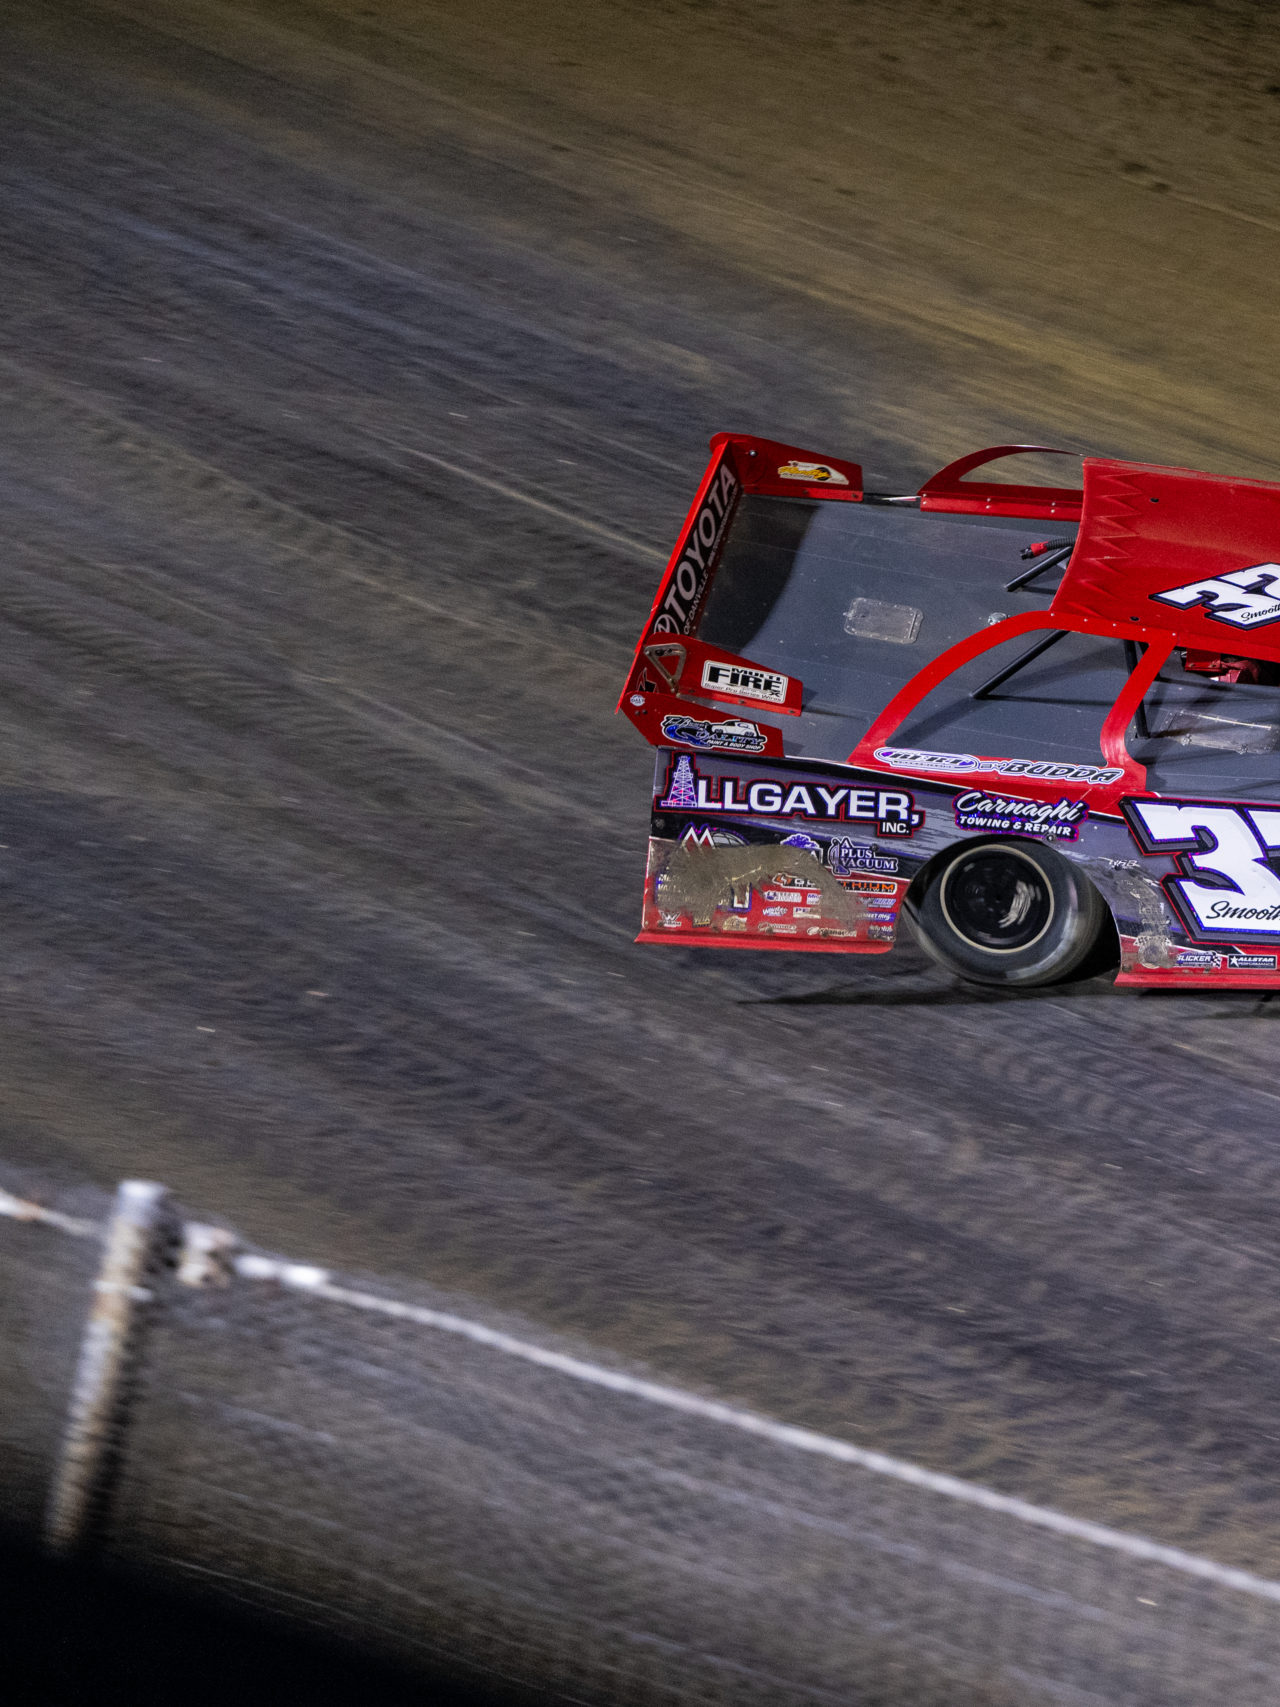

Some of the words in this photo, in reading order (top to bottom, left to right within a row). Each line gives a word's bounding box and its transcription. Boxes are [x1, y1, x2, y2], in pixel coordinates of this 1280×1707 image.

[664, 463, 736, 622] TOYOTA
[688, 571, 709, 620] DANVILLE
[708, 666, 782, 692] FIRE
[1002, 762, 1118, 783] BUDDA
[956, 792, 1082, 824] Carnaghi
[881, 821, 910, 835] INC.
[959, 815, 1011, 830] TOWING
[1012, 821, 1022, 830] &
[1024, 822, 1072, 837] REPAIR
[841, 839, 850, 848] A
[841, 848, 873, 859] PLUS
[841, 858, 895, 870] VACUUM
